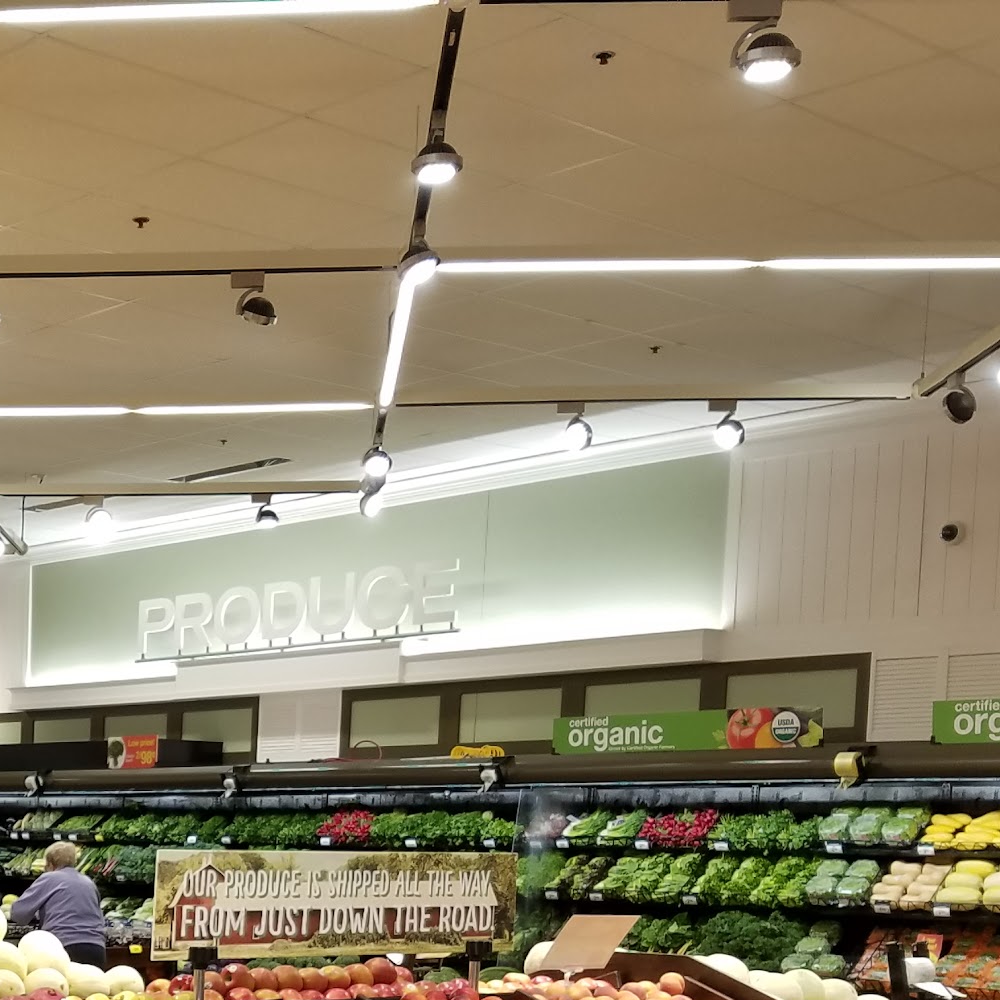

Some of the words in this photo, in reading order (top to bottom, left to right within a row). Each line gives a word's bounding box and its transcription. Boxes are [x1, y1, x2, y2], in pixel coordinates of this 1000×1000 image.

[137, 558, 460, 654] PRODUCE
[567, 720, 664, 752] organic
[569, 716, 609, 728] certified
[182, 869, 217, 898] OUR
[224, 870, 301, 899] PRODUCE
[307, 871, 321, 898] IS
[329, 870, 391, 899] SHIPPED
[396, 870, 422, 897] ALL
[427, 870, 453, 897] THE
[459, 870, 491, 897] WAY
[181, 905, 247, 938] FROM
[254, 906, 312, 937] JUST
[319, 906, 385, 935] DOWN
[395, 906, 431, 934] THE
[438, 905, 496, 933] ROAD!
